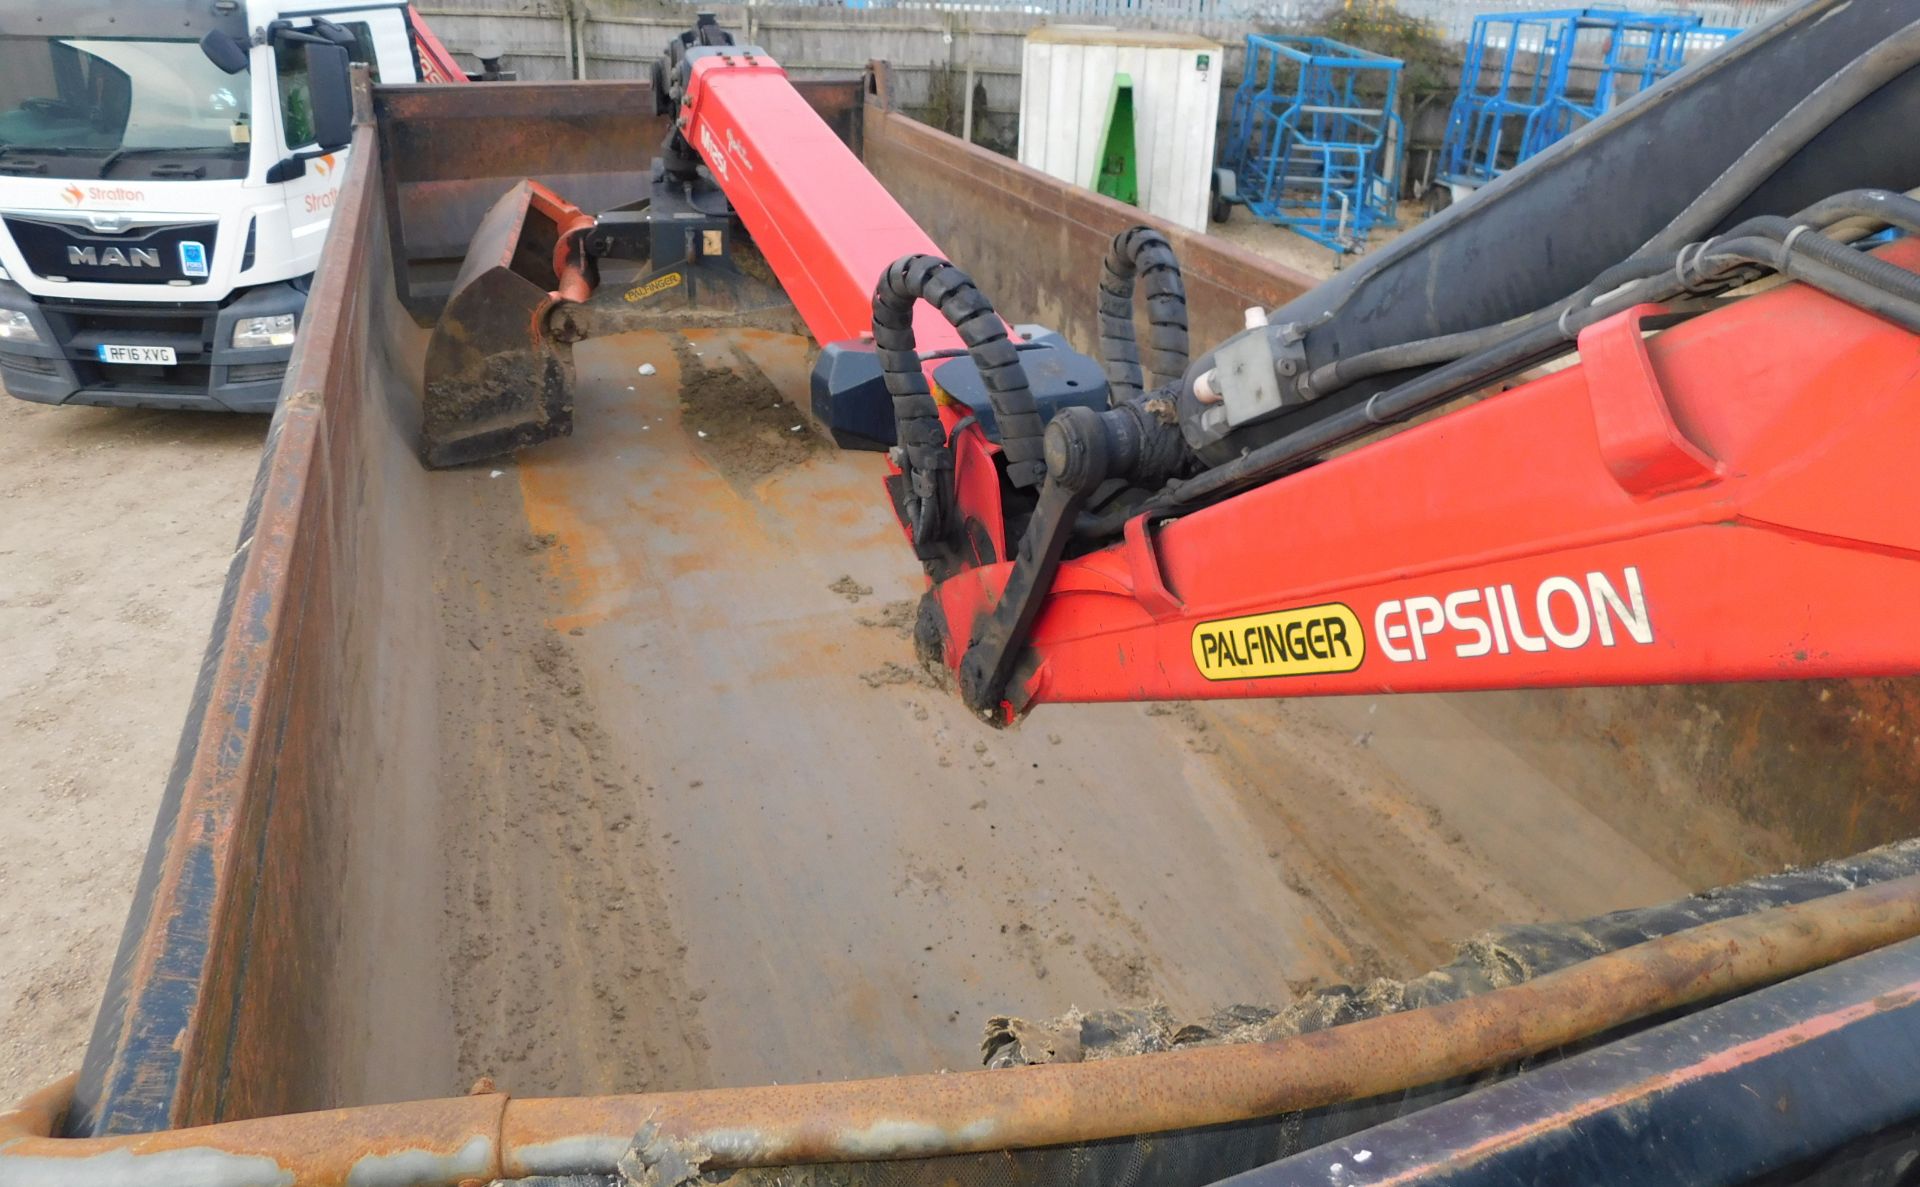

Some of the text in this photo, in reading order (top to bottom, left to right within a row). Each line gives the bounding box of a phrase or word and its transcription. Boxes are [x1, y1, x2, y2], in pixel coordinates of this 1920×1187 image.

[88, 187, 145, 201] Stratton
[67, 245, 160, 267] MAN
[627, 275, 678, 300] PALFINGER
[110, 347, 139, 361] RF16
[143, 348, 169, 362] XVG
[1200, 565, 1655, 669] PALFINGER EPSILON
